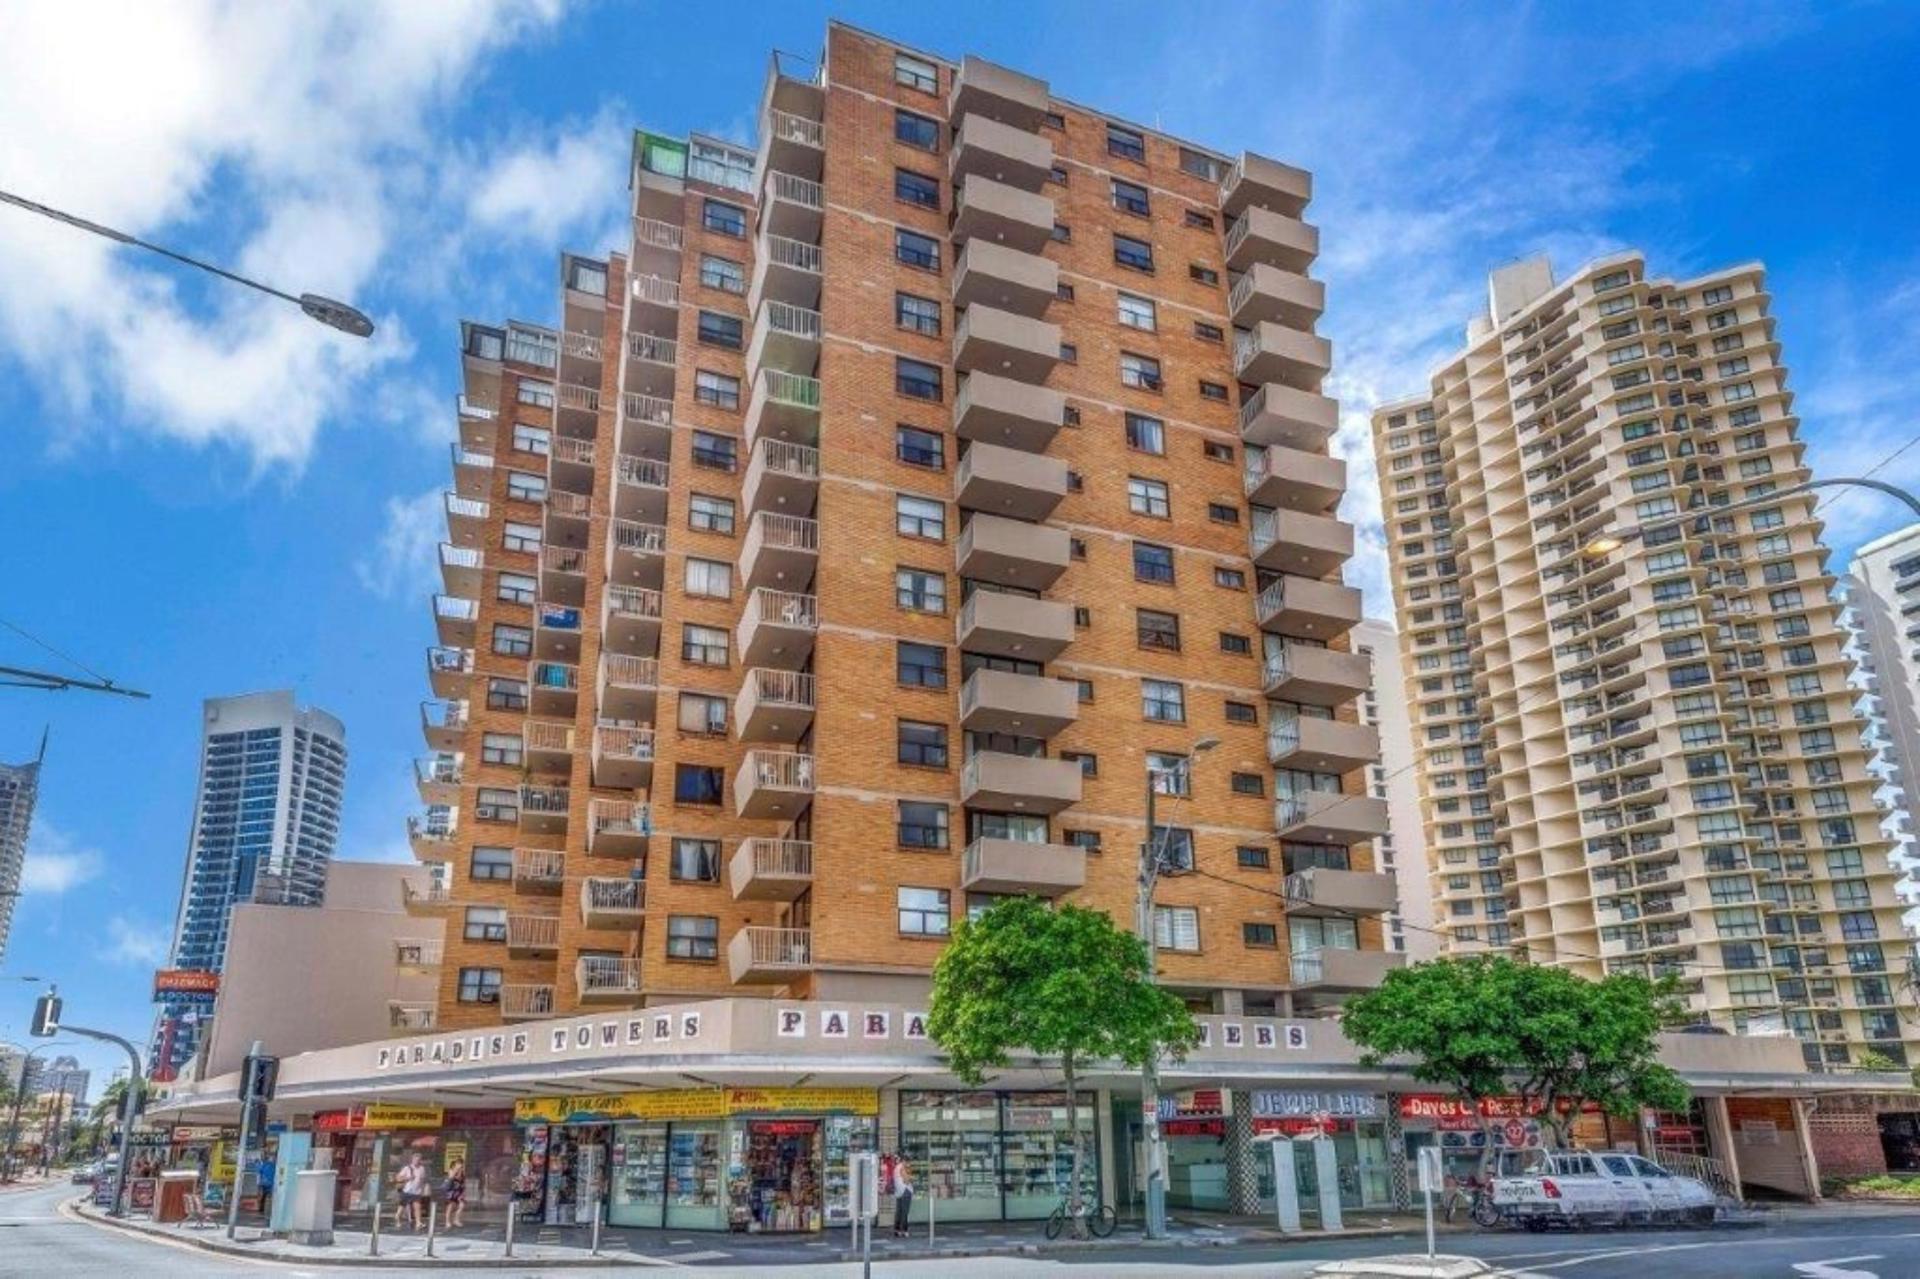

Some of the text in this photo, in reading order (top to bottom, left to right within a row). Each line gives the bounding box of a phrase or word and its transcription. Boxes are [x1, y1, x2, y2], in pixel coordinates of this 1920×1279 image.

[379, 1017, 700, 1066] PARADISE TOWERS
[1411, 1098, 1456, 1116] Daves
